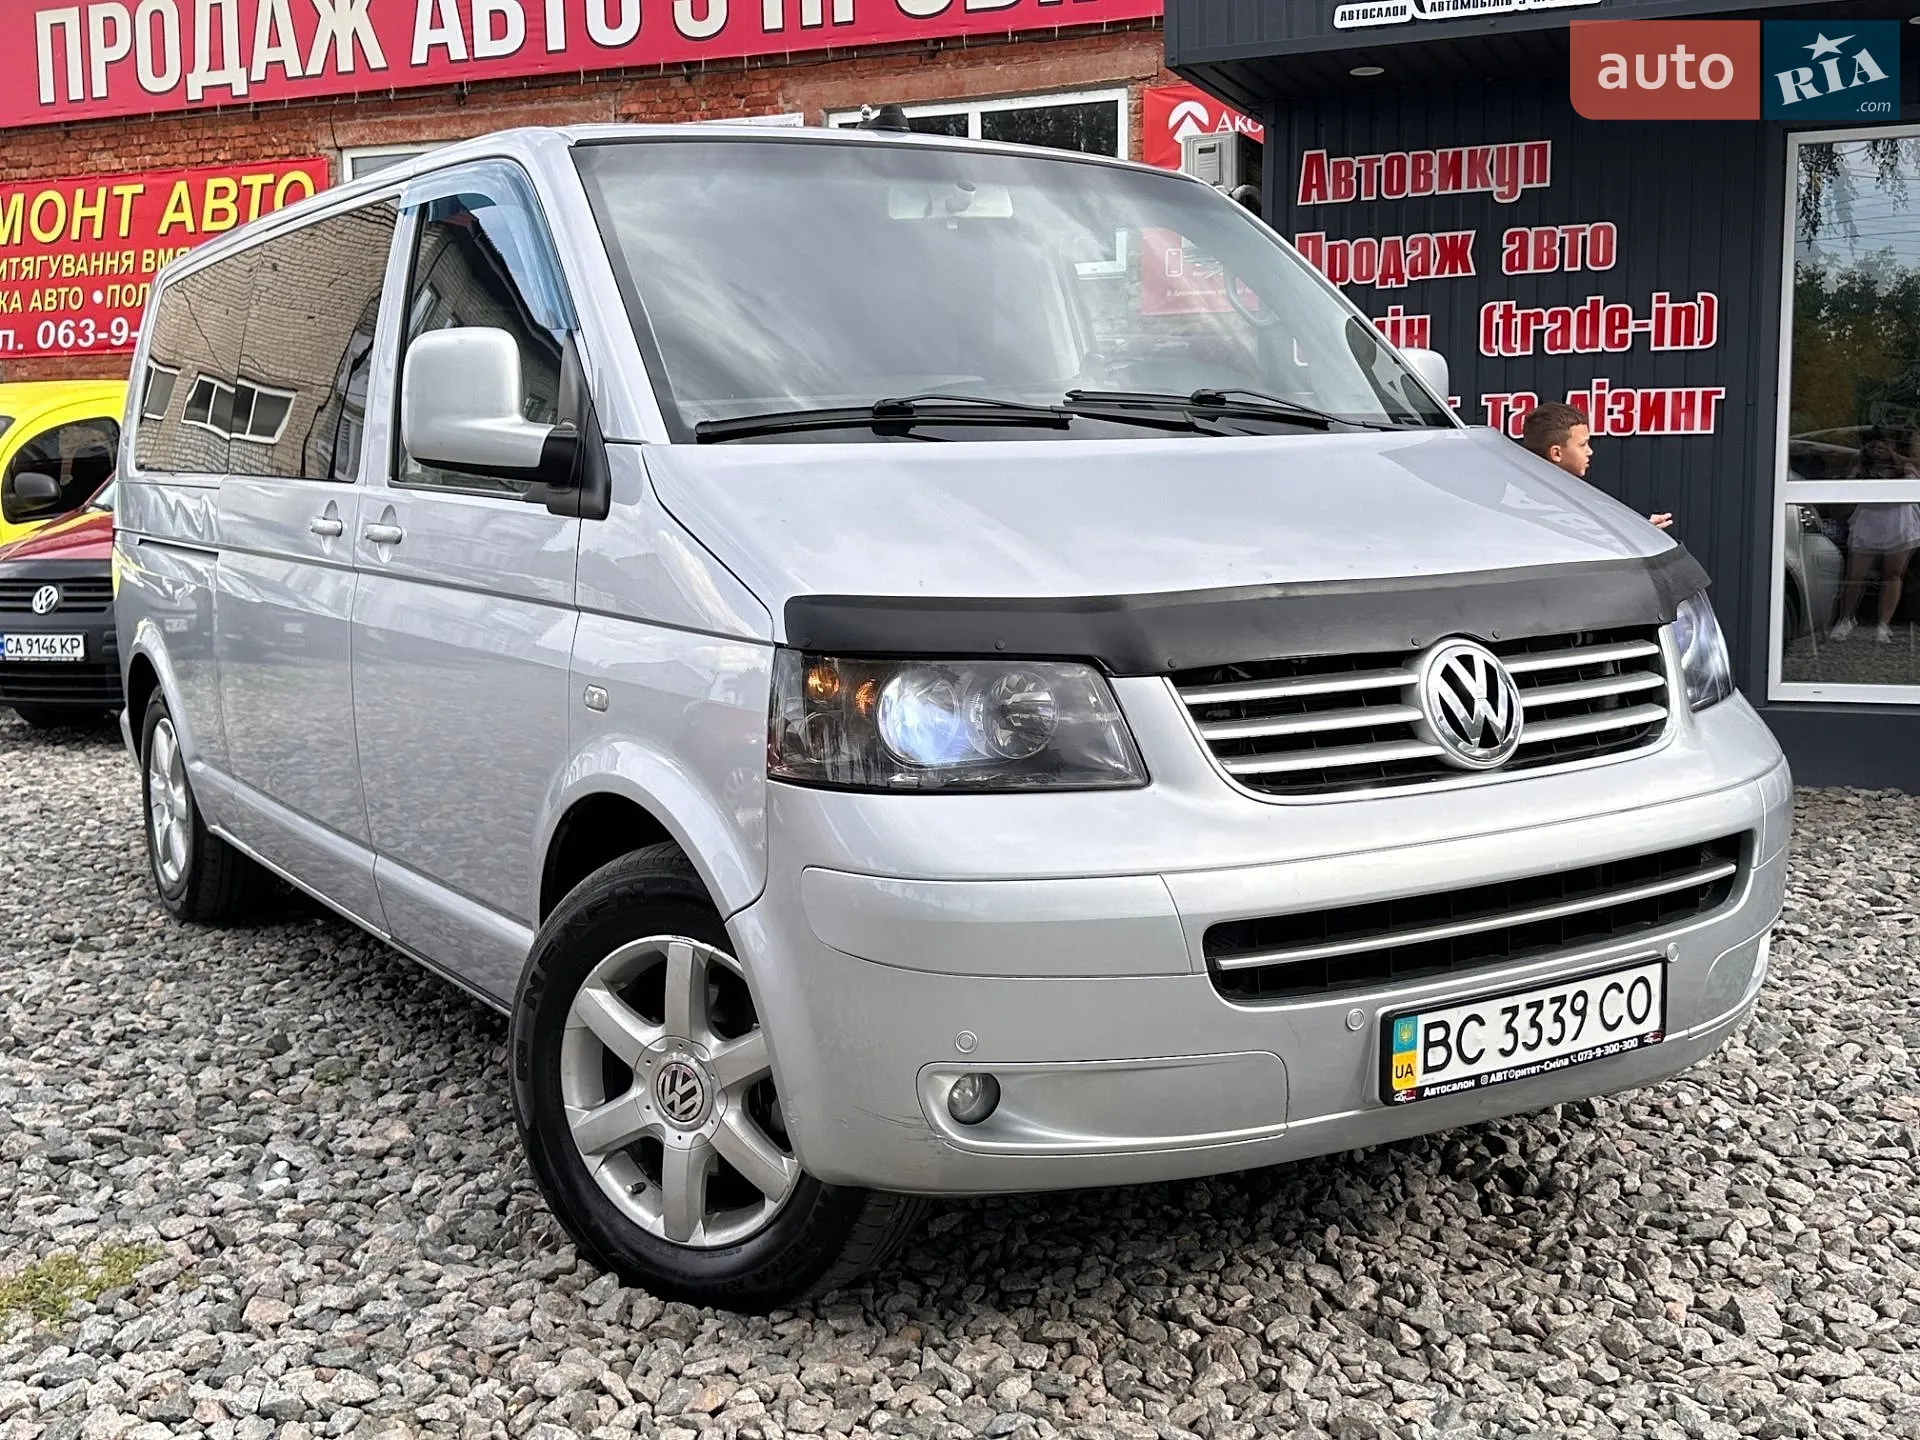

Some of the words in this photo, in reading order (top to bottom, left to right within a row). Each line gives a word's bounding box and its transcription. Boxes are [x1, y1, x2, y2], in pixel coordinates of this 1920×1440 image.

[1340, 5, 1407, 22] АВТОСАЛОН
[36, 0, 388, 103] ПРОДАЖ
[158, 170, 315, 235] АВТО
[1297, 140, 1552, 205] Автовикуп
[1295, 230, 1476, 289] Продаж
[1502, 222, 1617, 276] авто
[28, 287, 84, 313] АВТО
[1480, 291, 1718, 357] (trade-in)
[1481, 392, 1538, 439] та
[26, 638, 57, 654] 9146
[1423, 1013, 1486, 1074] BC
[1499, 989, 1589, 1058] 3339
[1599, 975, 1652, 1032] CO
[1395, 1063, 1414, 1080] UA
[1423, 1079, 1476, 1098] Автосалон
[1577, 1037, 1639, 1062] 073-9-300-300
